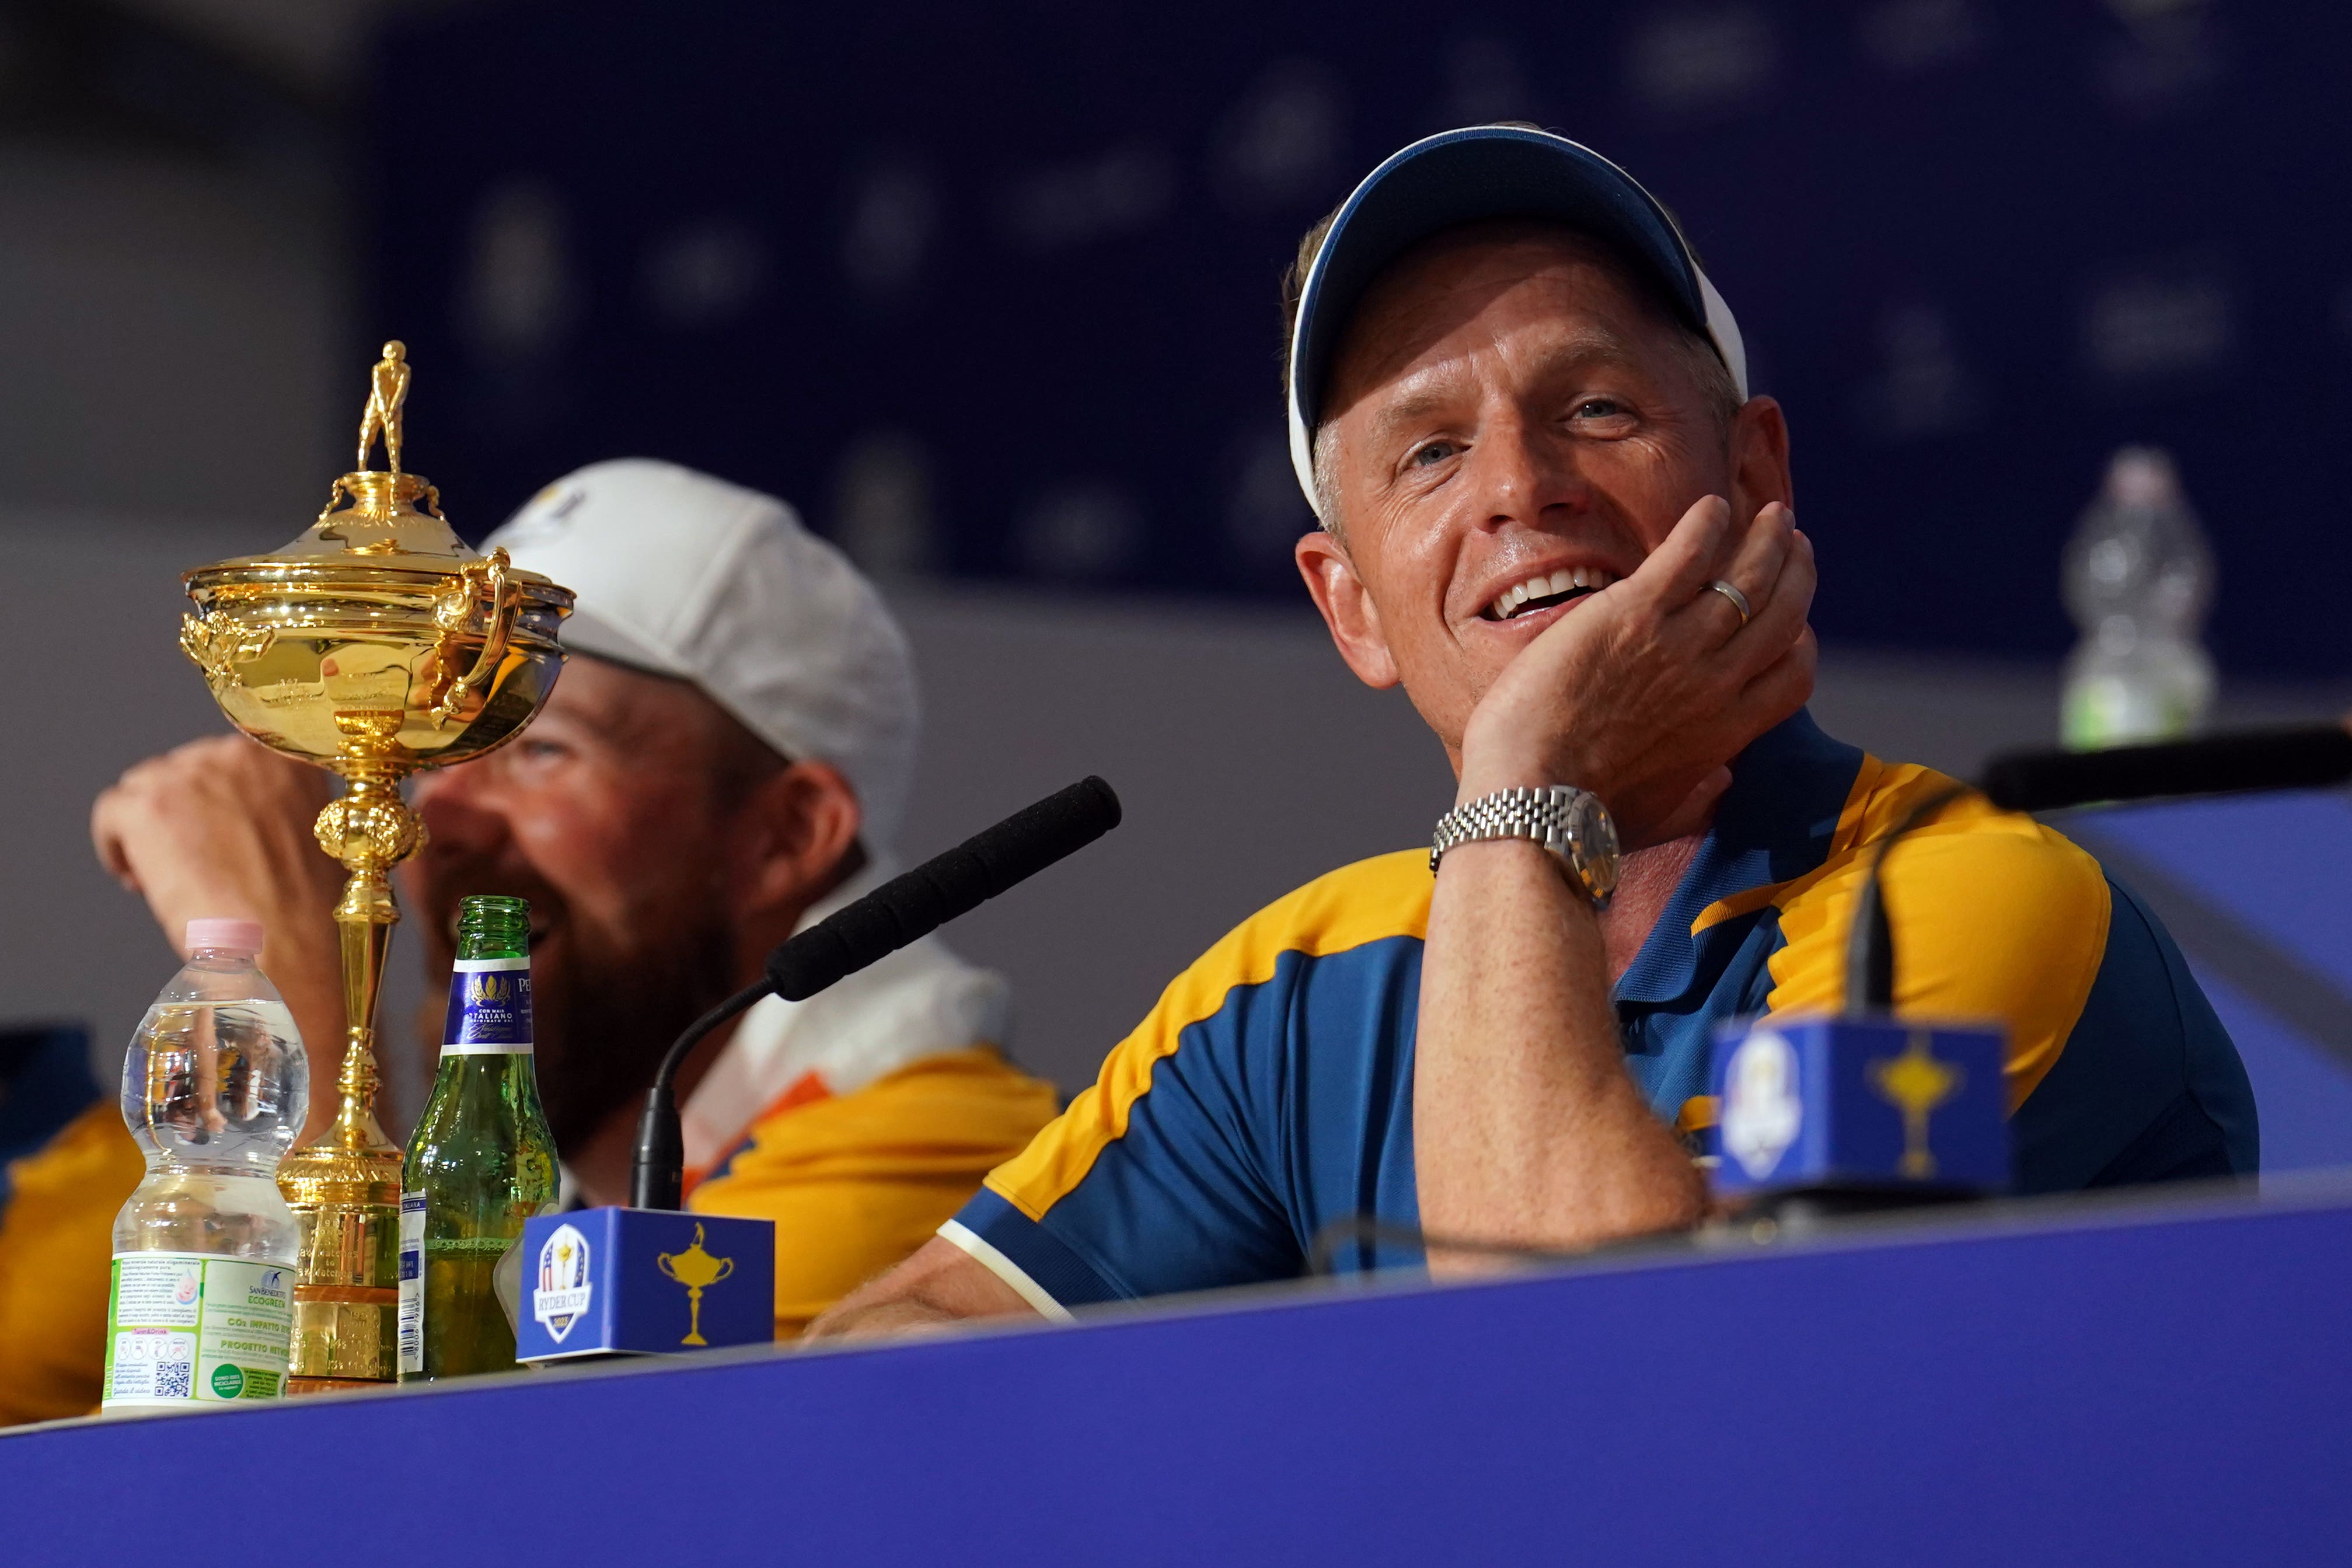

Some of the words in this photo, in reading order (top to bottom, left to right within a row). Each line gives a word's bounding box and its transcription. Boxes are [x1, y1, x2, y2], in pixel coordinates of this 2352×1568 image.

[248, 1295, 286, 1309] ECOGREEN
[538, 1296, 567, 1312] RYDER
[567, 1292, 586, 1308] CUP
[250, 1319, 280, 1332] IMPATTO
[221, 1339, 268, 1353] PROGETTO
